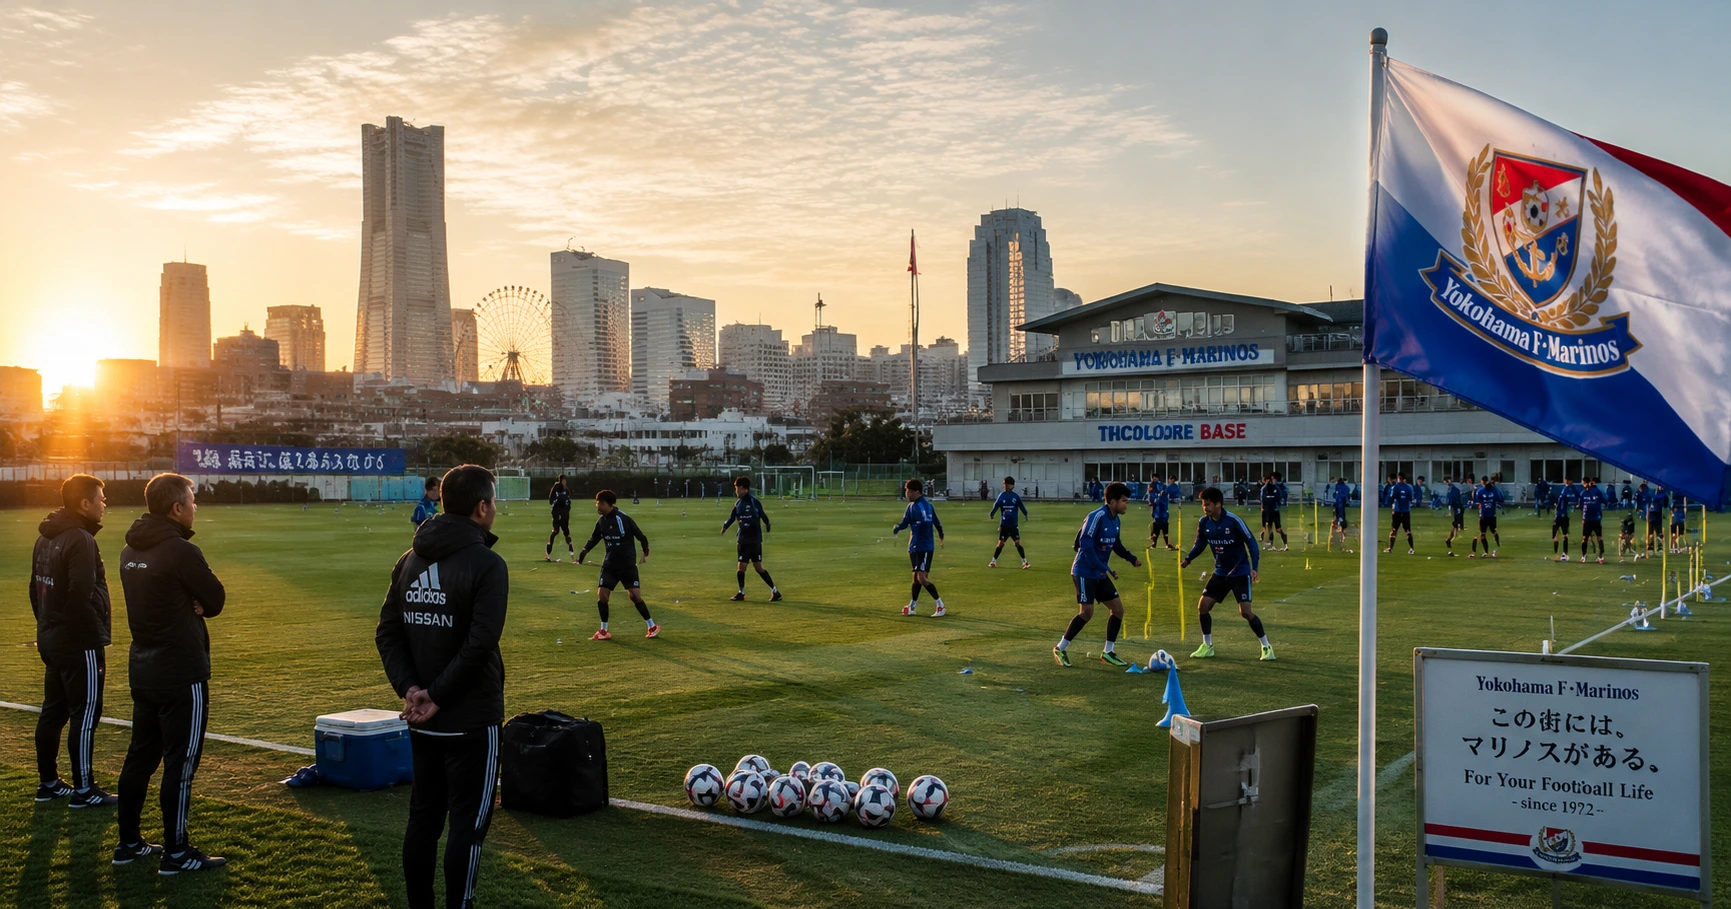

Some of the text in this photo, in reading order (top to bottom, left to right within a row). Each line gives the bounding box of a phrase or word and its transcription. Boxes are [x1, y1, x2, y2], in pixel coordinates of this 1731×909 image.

[1440, 276, 1530, 351] Yokohama
[1200, 423, 1247, 440] BASE
[403, 611, 453, 628] NISSAN
[1475, 675, 1554, 695] Yokohama
[1491, 707, 1625, 739] この街には。
[1461, 736, 1660, 773] マリノスがある。
[1464, 769, 1492, 786] For
[1496, 772, 1537, 790] Your
[1620, 783, 1655, 801] Life
